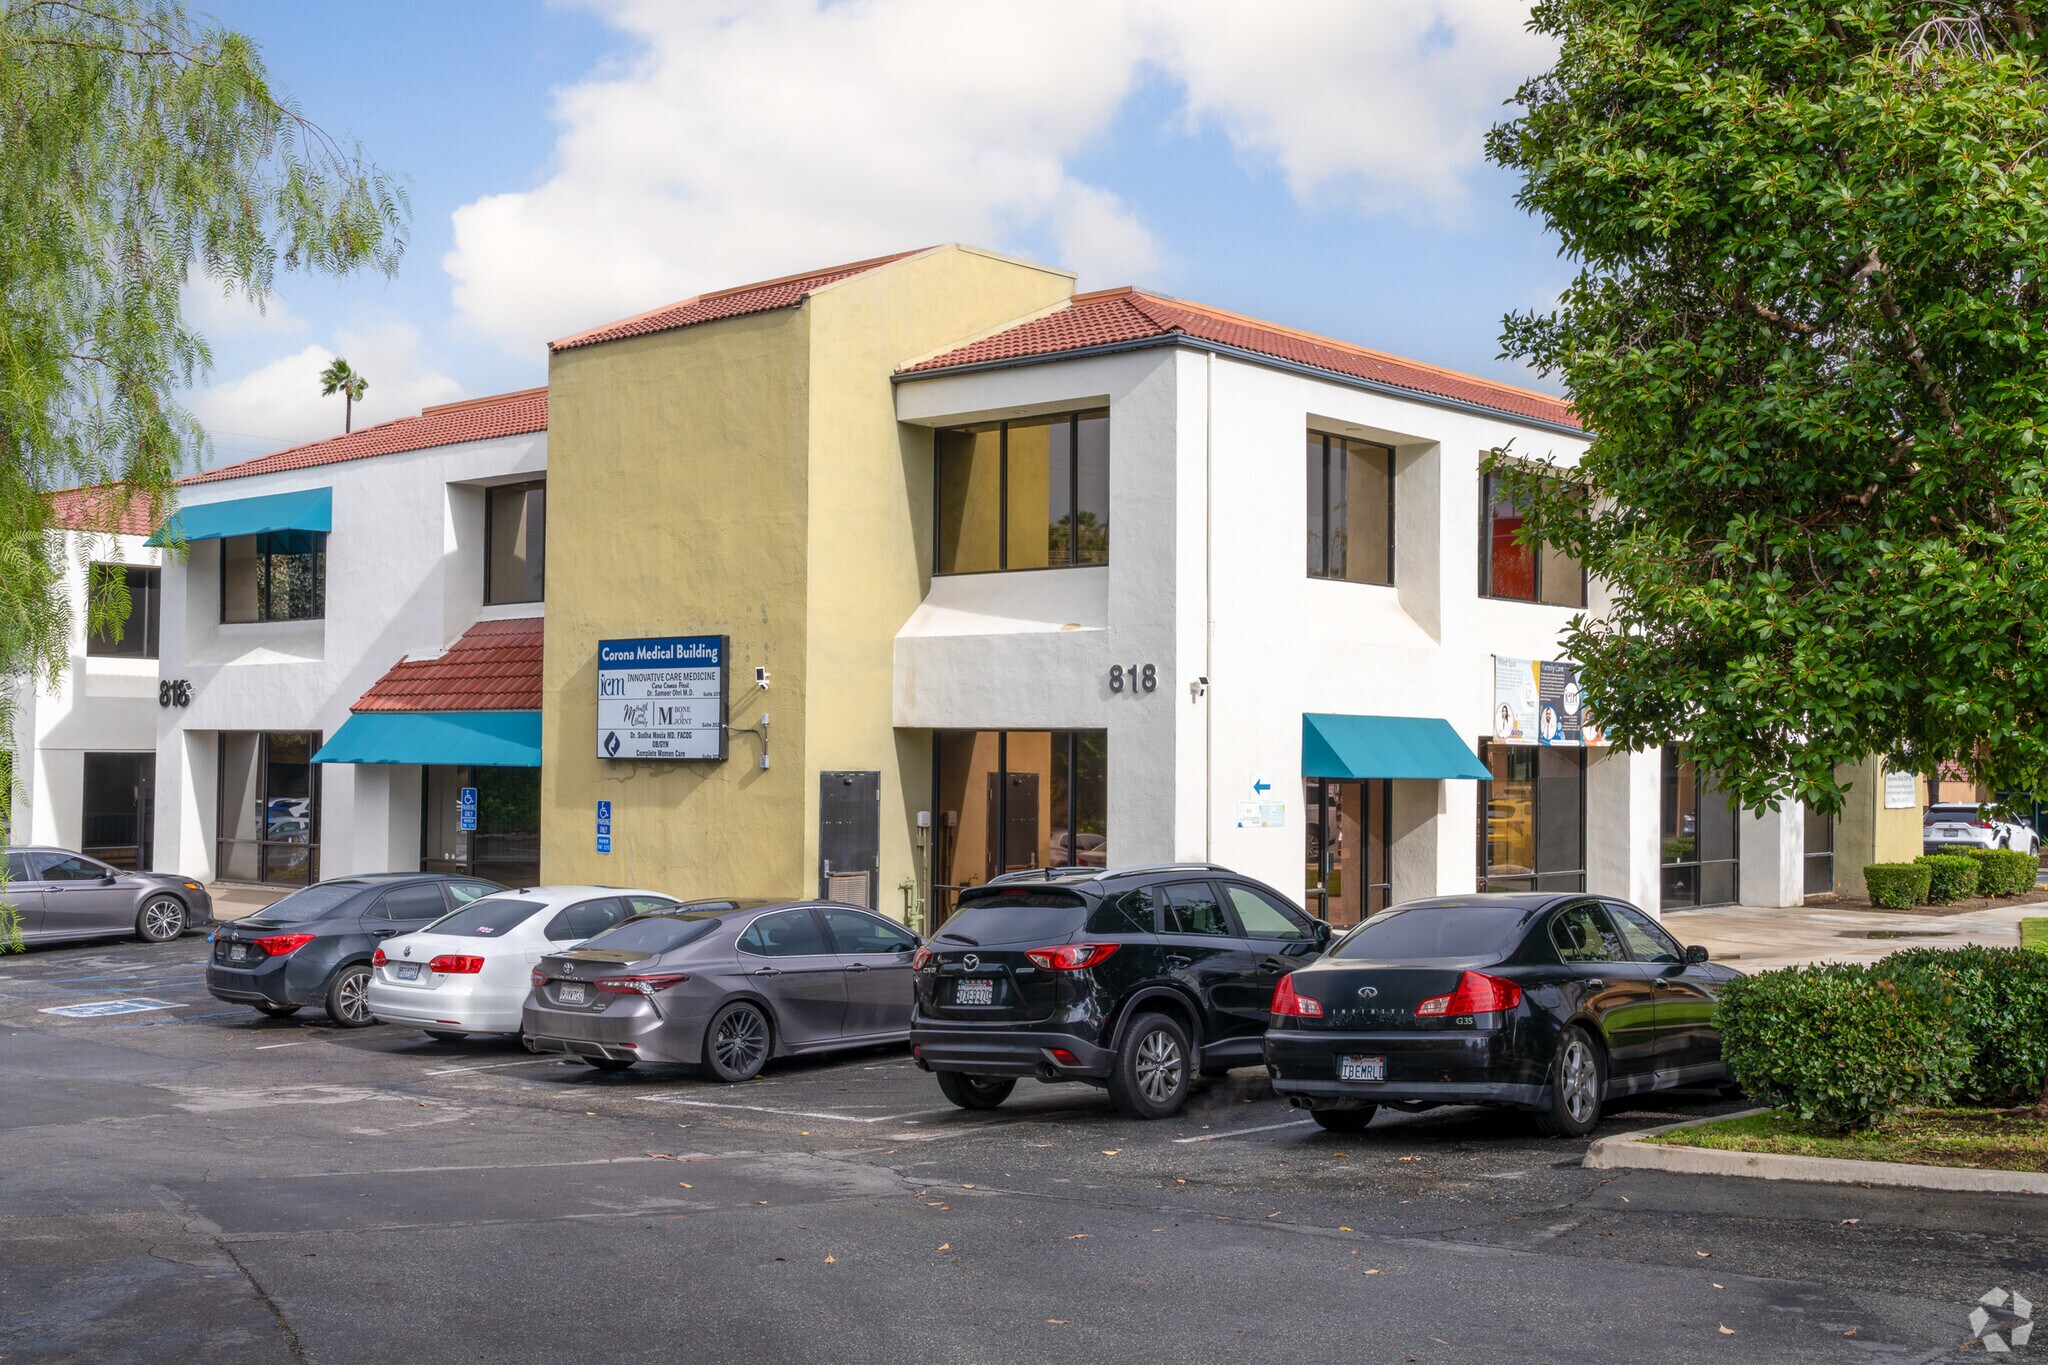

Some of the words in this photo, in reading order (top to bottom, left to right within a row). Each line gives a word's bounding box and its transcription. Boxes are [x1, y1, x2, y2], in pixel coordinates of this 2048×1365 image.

[602, 647, 634, 661] Corona
[637, 645, 674, 660] Medical
[676, 643, 718, 663] Building
[1541, 663, 1554, 673] Family
[1555, 664, 1564, 673] Care
[627, 673, 664, 683] INNOVATIVE
[665, 672, 682, 682] CARE
[683, 671, 716, 681] MEDICINE
[1109, 664, 1158, 693] 818
[600, 673, 626, 696] icm
[159, 679, 191, 708] 818
[654, 689, 671, 697] Sameer
[658, 706, 674, 726] M
[674, 718, 692, 726] JOINT
[637, 731, 651, 739] Sudha
[653, 731, 666, 739] Moola
[677, 731, 692, 739] FACOG
[652, 740, 669, 748] OB/GYN
[636, 749, 657, 758] Complete
[657, 749, 675, 758] Women
[675, 749, 686, 758] Care
[1456, 1016, 1474, 1026] G35
